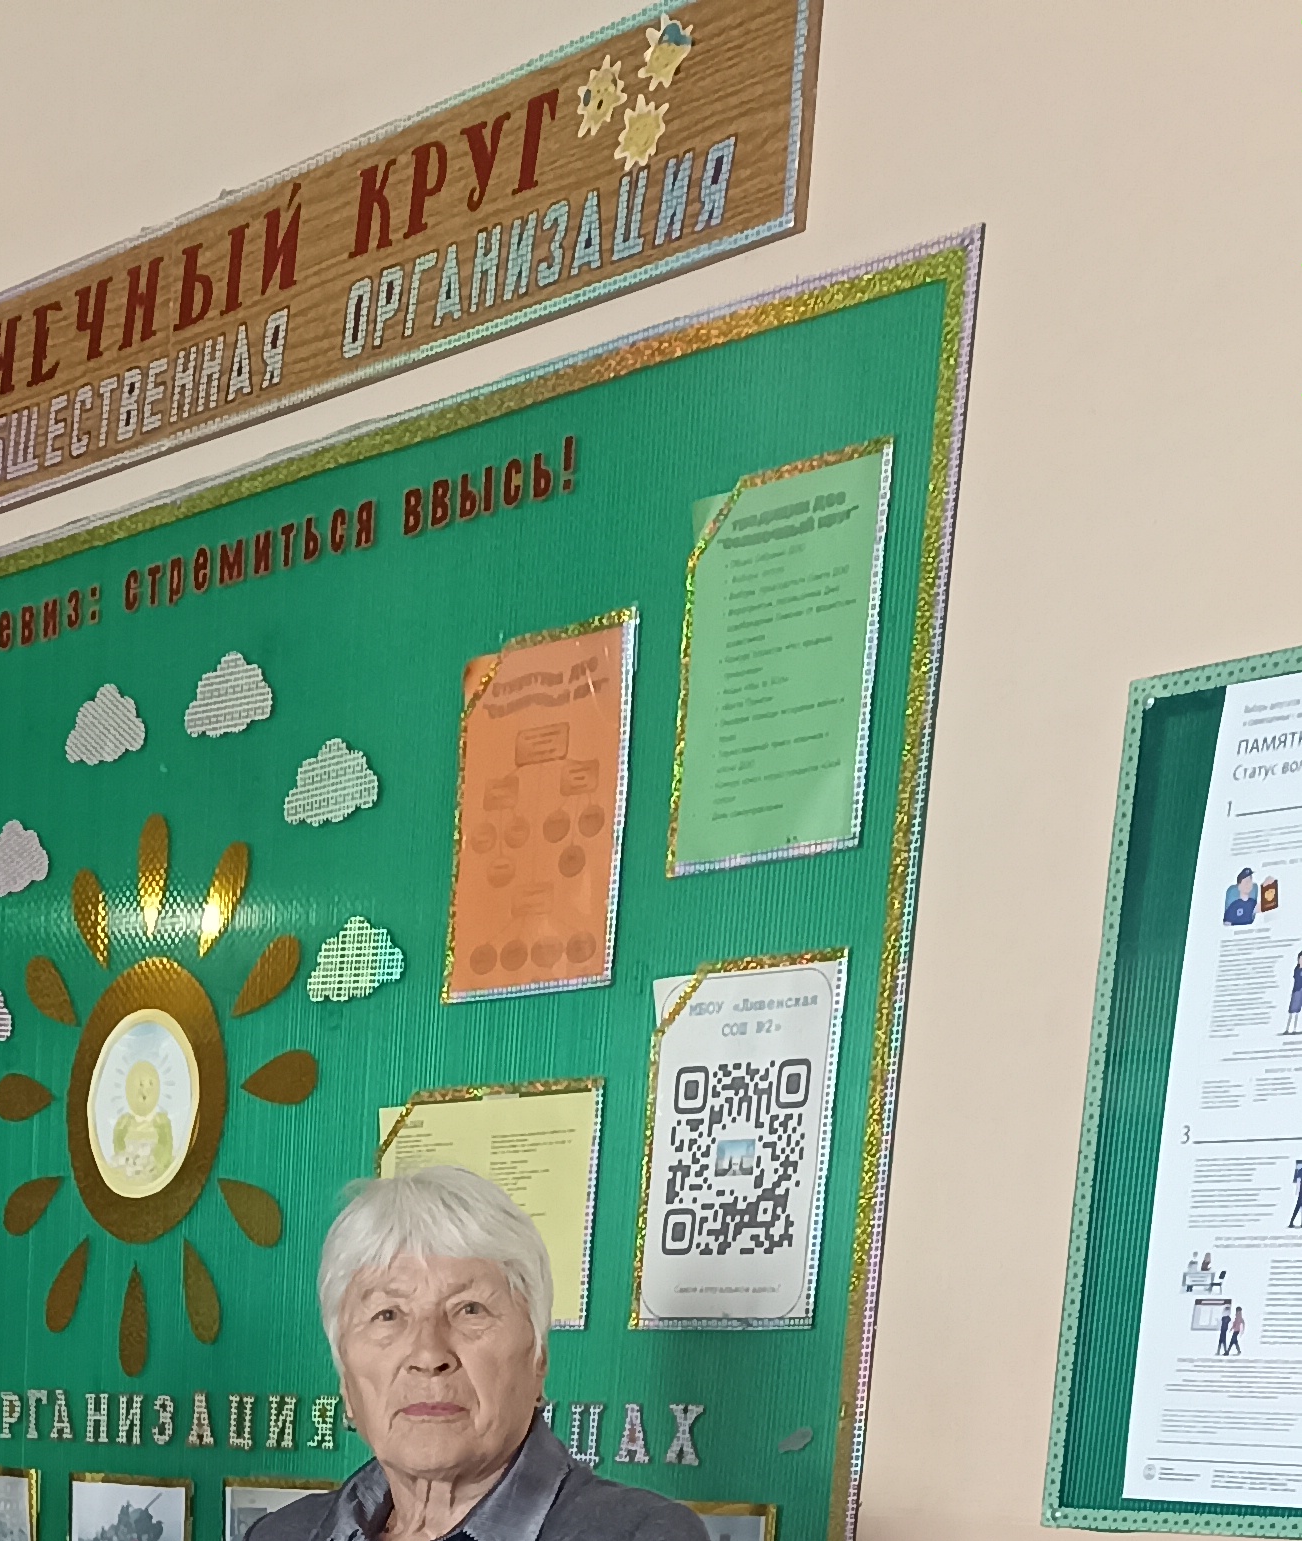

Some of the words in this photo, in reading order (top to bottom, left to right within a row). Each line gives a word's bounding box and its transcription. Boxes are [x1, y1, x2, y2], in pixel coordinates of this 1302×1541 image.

[348, 88, 560, 258] КРУГ
[340, 134, 738, 359] ОРГАНИЗАЦИЯ
[123, 500, 377, 612] стремиться
[402, 435, 577, 537] ввысь!
[1233, 762, 1279, 781] Статус
[688, 1000, 726, 1017] МБОУ
[1180, 1124, 1191, 1144] 3
[541, 1402, 704, 1467] ЦАХ
